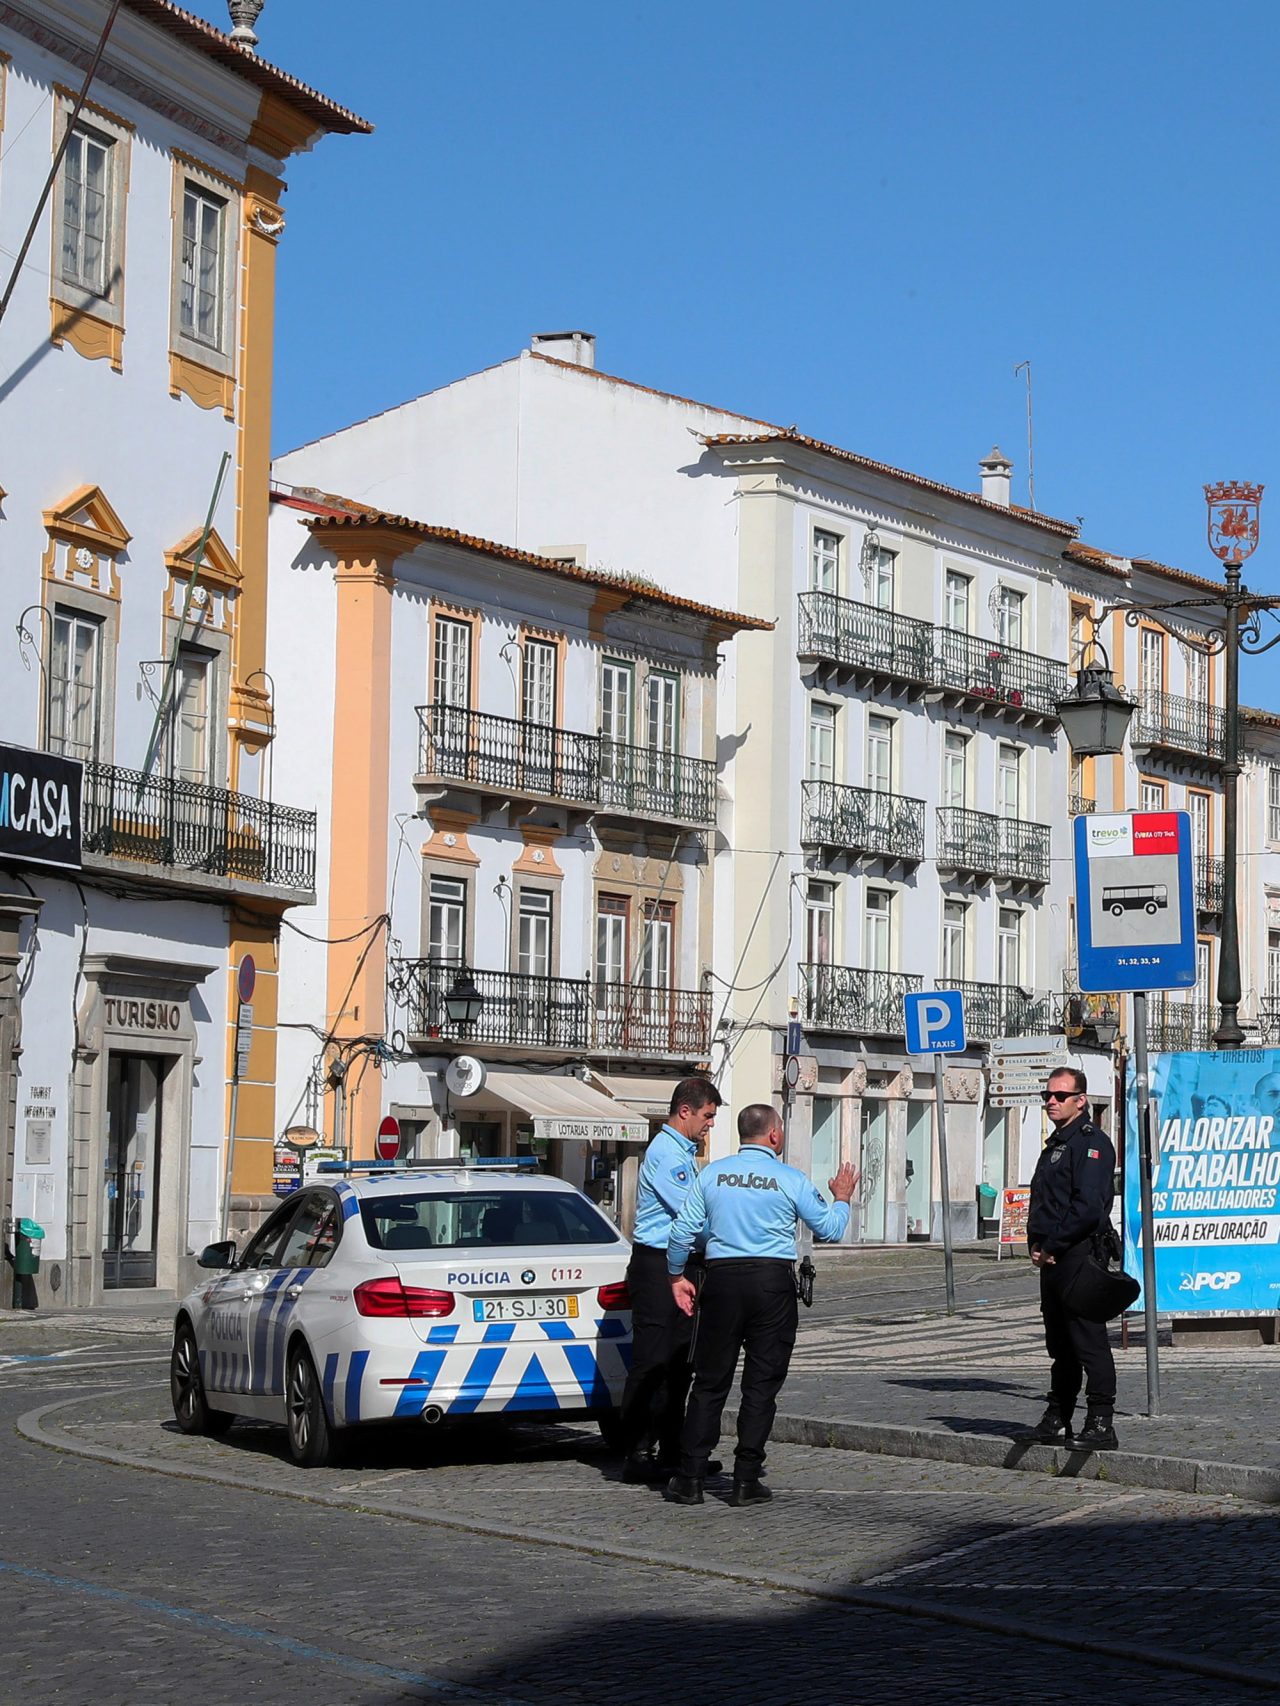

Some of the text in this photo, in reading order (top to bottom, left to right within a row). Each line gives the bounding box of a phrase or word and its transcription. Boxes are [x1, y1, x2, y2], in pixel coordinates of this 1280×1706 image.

[1092, 830, 1118, 838] trevo
[1118, 958, 1128, 966] 31,
[1129, 958, 1140, 966] 32,
[1140, 957, 1151, 965] 33,
[104, 998, 181, 1031] TURISMO
[917, 998, 951, 1050] P
[931, 1040, 956, 1049] TAXIS
[1222, 1050, 1265, 1064] DIREITOS!
[558, 1124, 589, 1136] LOTARIAS
[593, 1126, 613, 1137] PINTO
[717, 1173, 779, 1191] POLÍCIA
[1171, 1189, 1277, 1211] TRABALHADORES
[1154, 1218, 1268, 1244] NÃO À EXPLORAÇÃO
[447, 1268, 583, 1285] POLÍCIA 112
[1193, 1271, 1241, 1291] PCP
